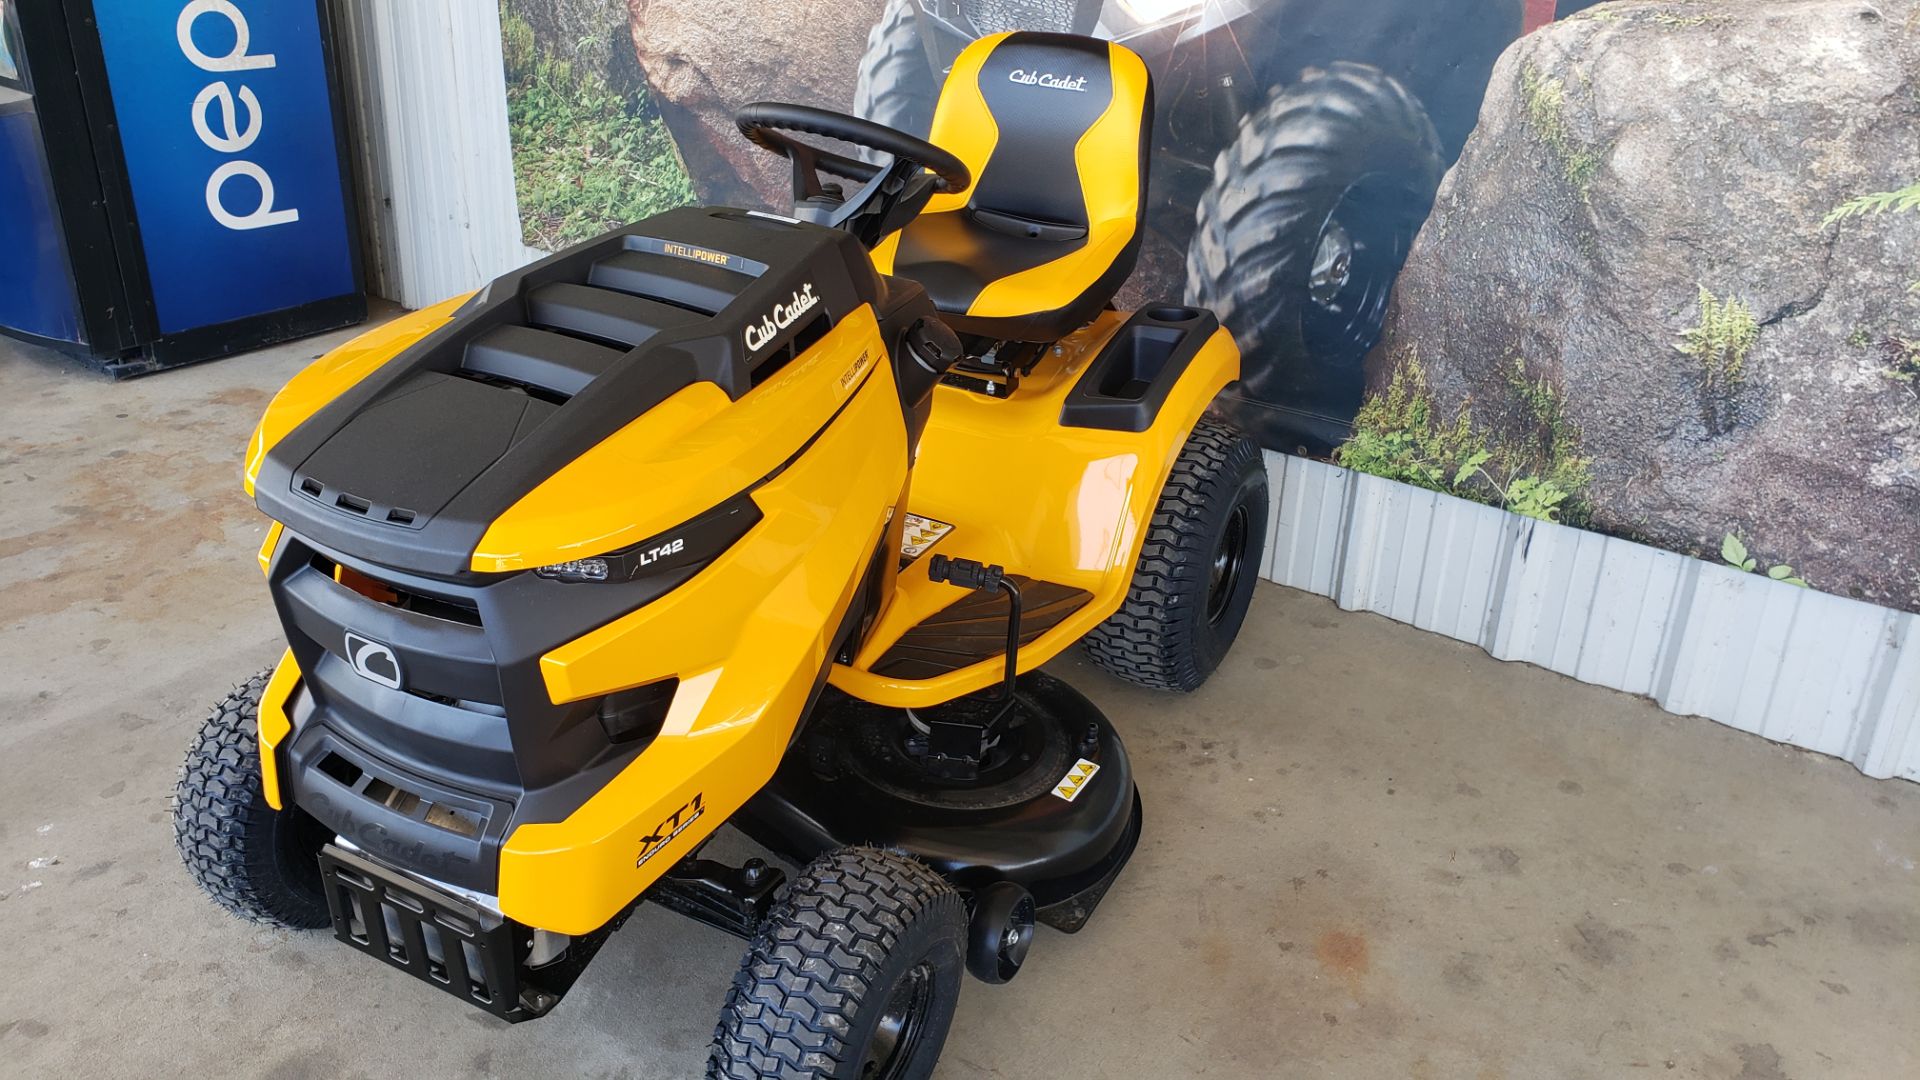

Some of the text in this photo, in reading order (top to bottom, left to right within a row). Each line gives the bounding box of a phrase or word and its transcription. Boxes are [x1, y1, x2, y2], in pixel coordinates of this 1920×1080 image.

[1009, 69, 1087, 92] Cub Cadet
[176, 0, 299, 230] pep
[745, 283, 819, 351] Cub Cadet
[640, 538, 684, 566] LT42
[357, 820, 474, 872] Cadet
[637, 791, 703, 858] XT1
[638, 811, 701, 867] ENDURO SERIES
